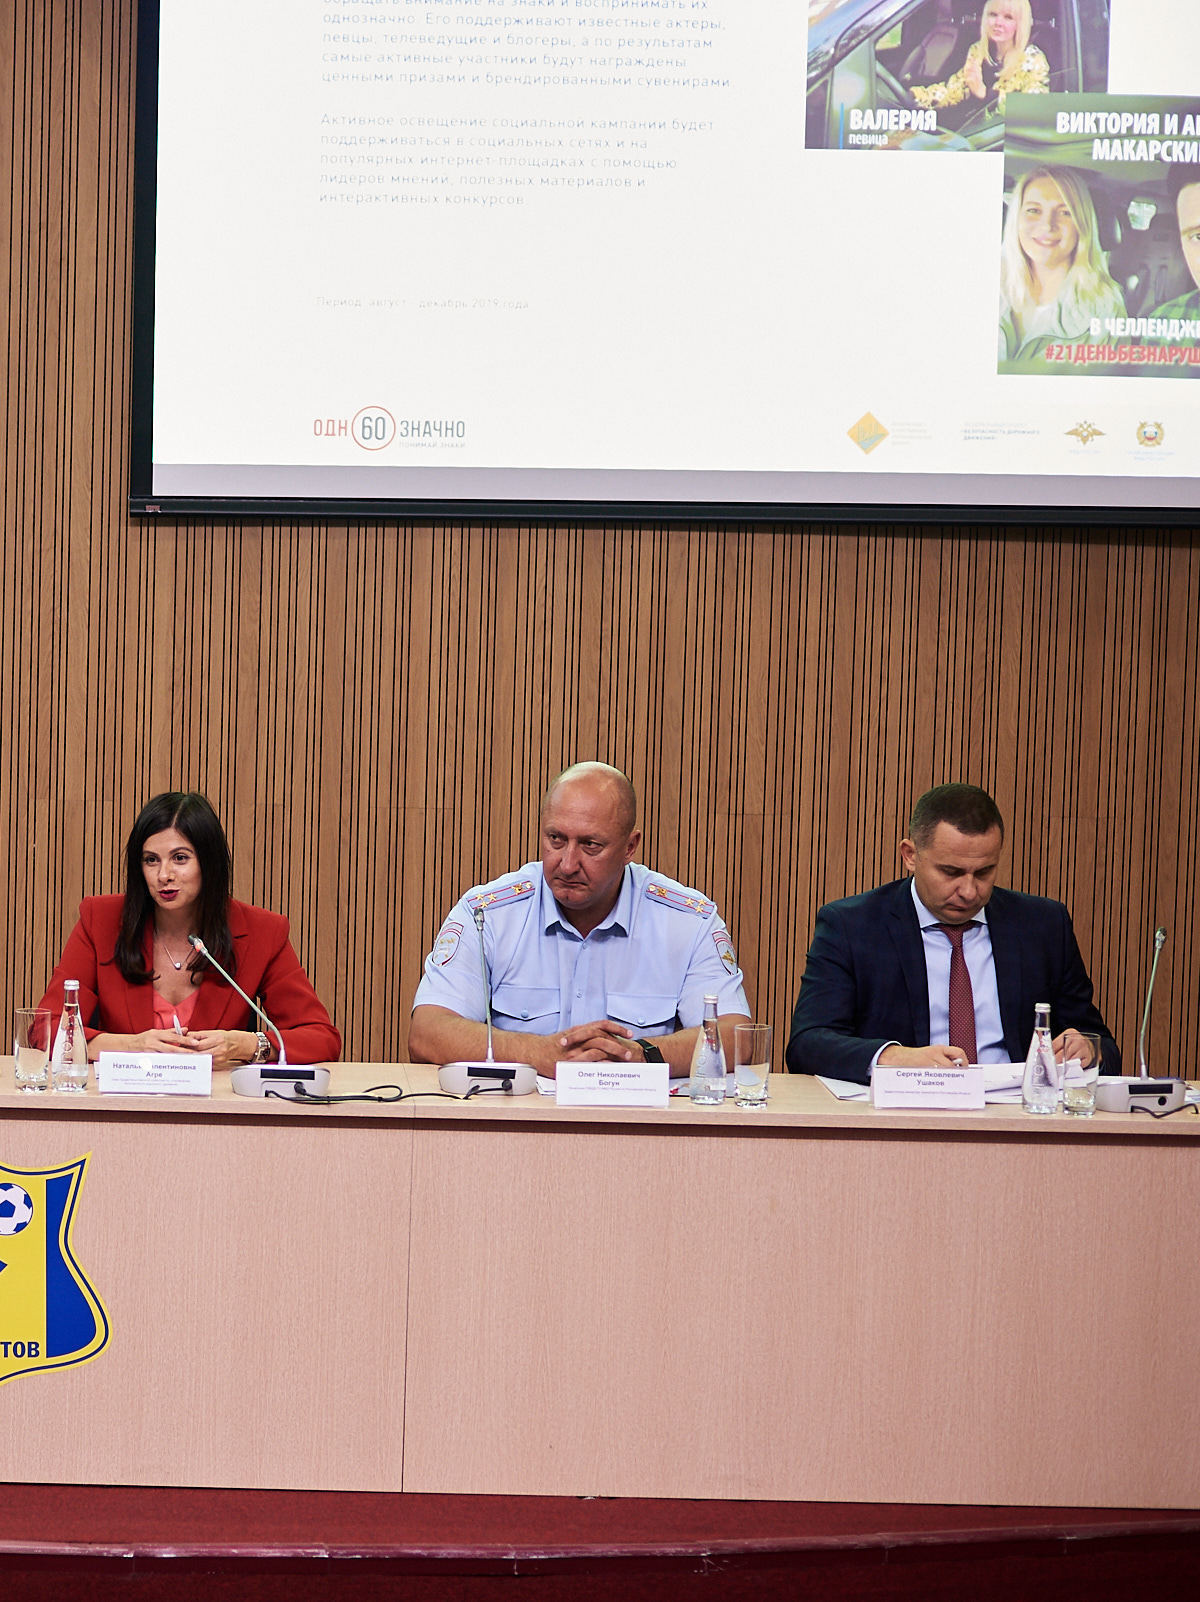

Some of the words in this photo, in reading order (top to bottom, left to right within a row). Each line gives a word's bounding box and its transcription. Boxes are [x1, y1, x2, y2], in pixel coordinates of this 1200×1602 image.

[850, 109, 937, 131] ВАЛЕРИЯ
[1056, 112, 1160, 135] ВИКТОРИЯ
[1164, 113, 1179, 135] И
[849, 132, 888, 145] певица
[1092, 138, 1200, 163] МАКАРСКИ
[1090, 318, 1101, 336] В
[313, 419, 347, 437] ОДН
[361, 416, 385, 440] 60
[400, 420, 465, 438] ЗНАЧНО
[149, 1063, 197, 1071] лентиновна
[924, 1071, 965, 1079] Яковлевич
